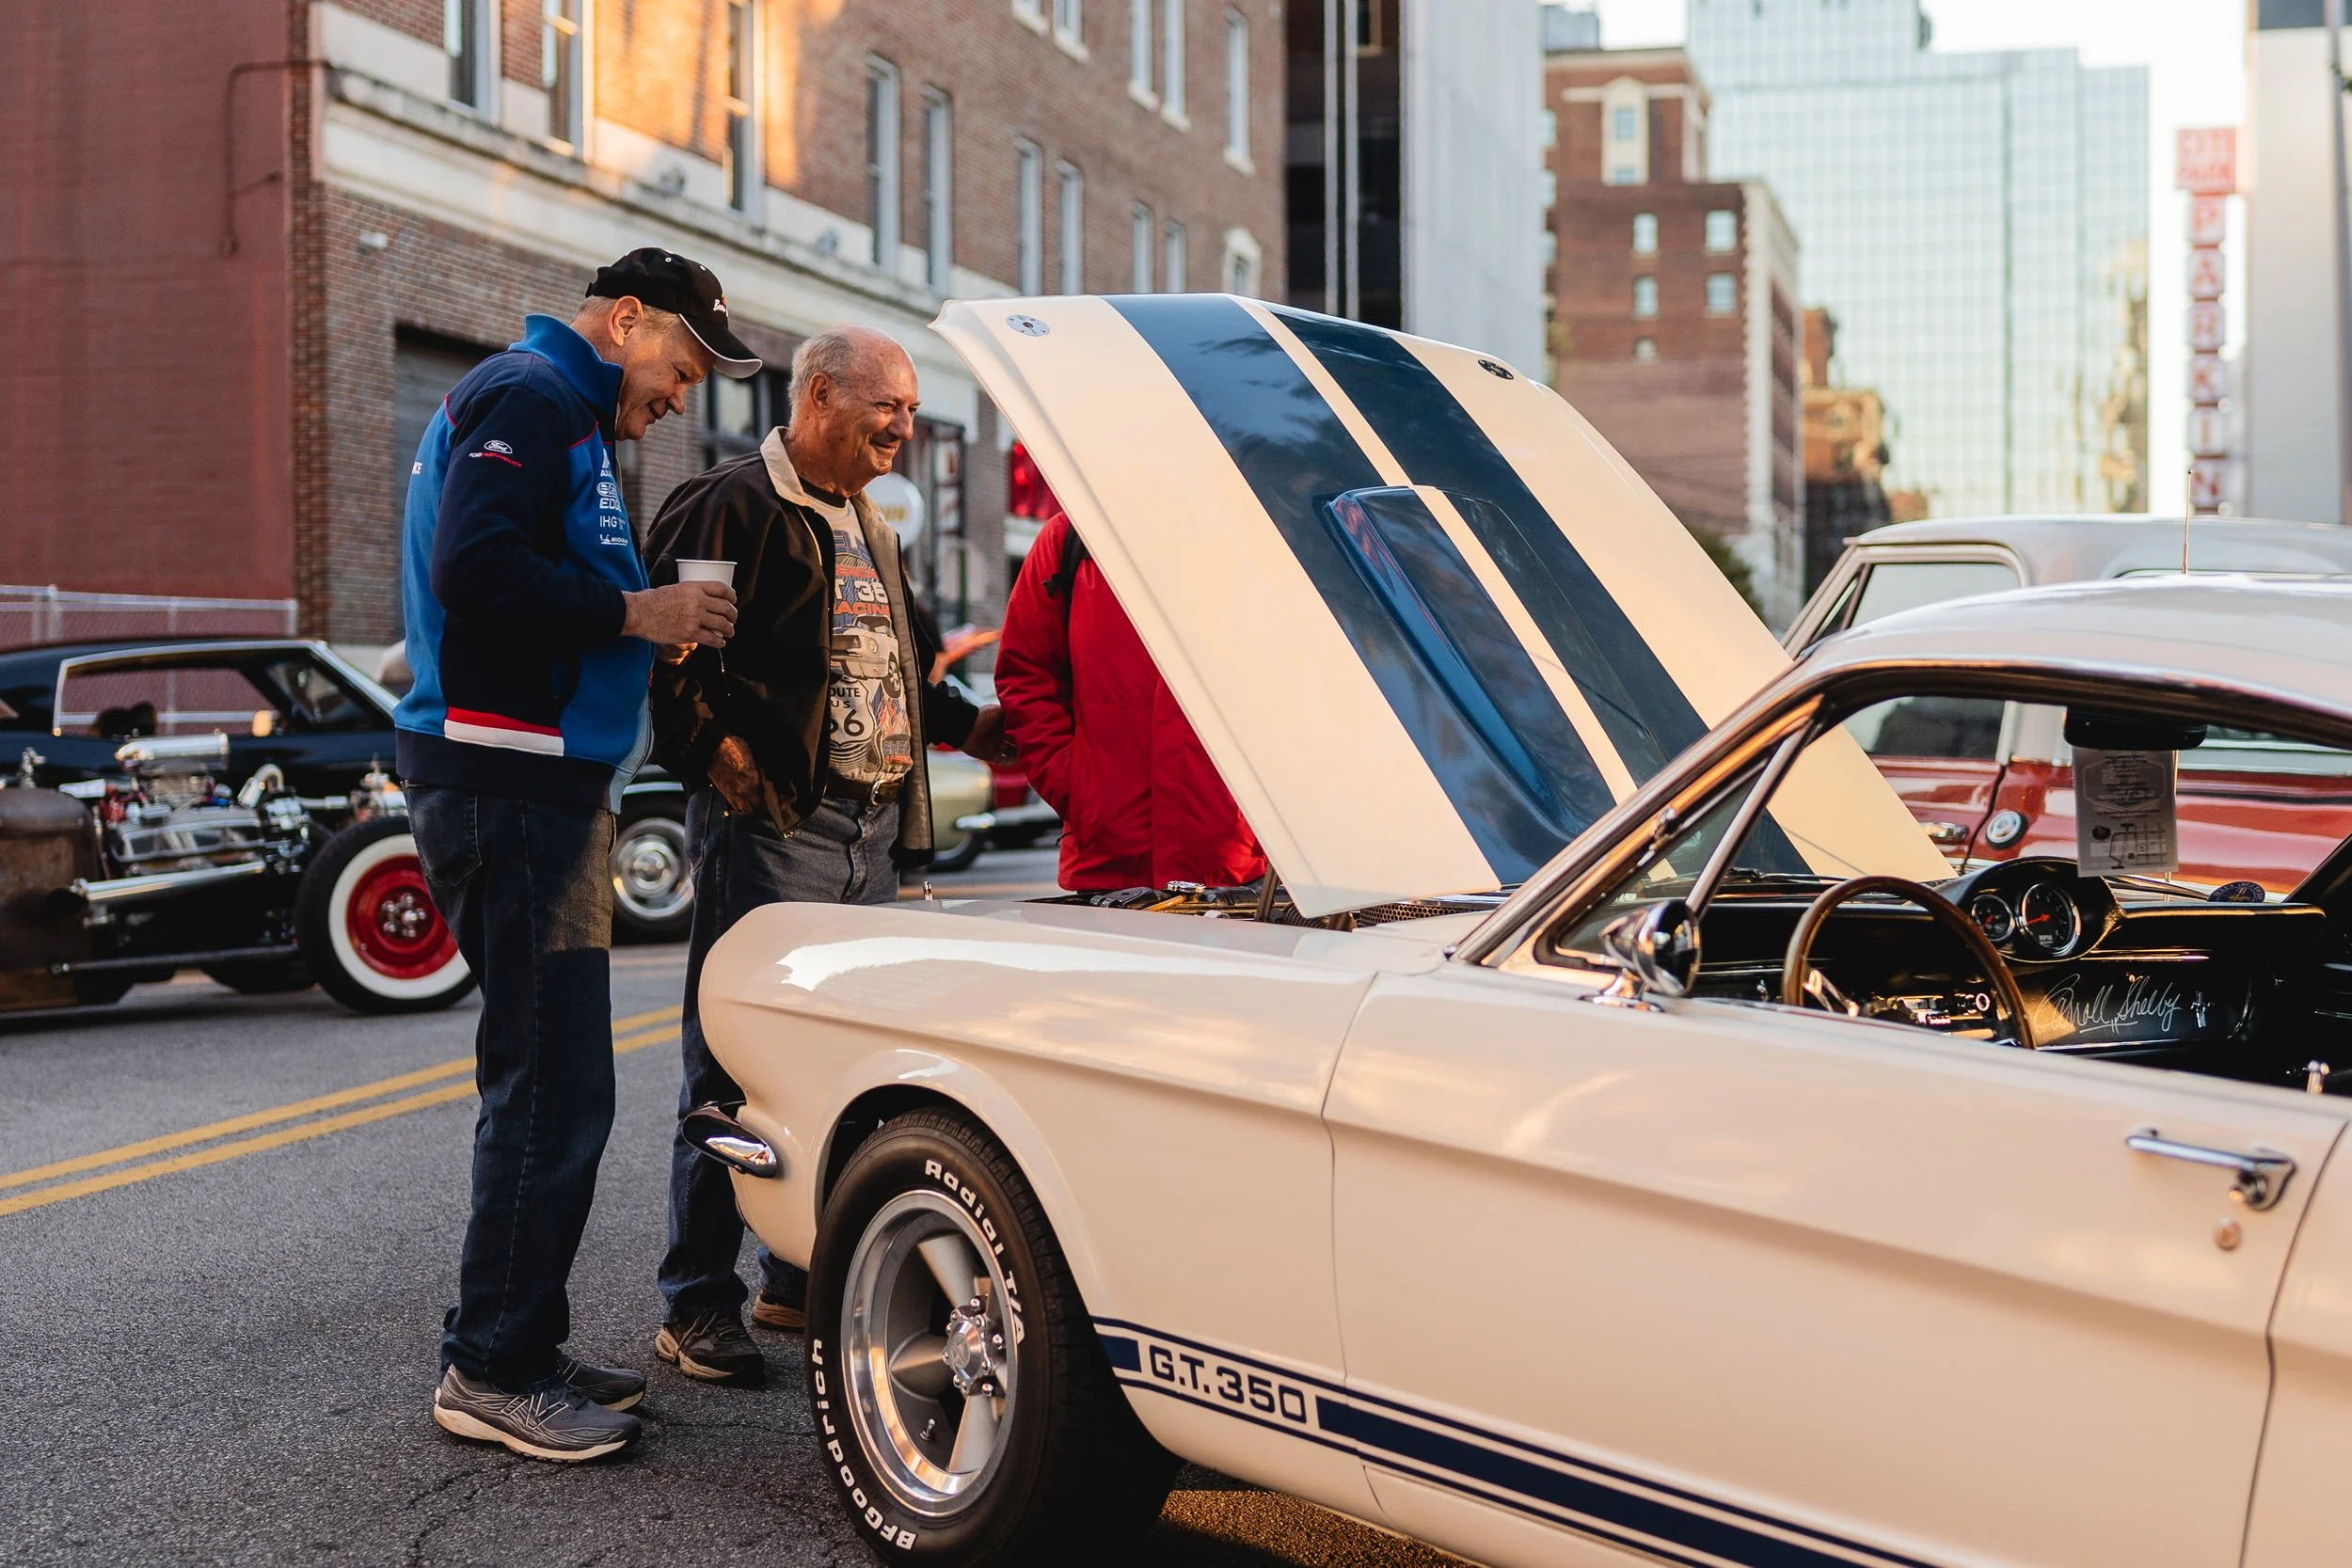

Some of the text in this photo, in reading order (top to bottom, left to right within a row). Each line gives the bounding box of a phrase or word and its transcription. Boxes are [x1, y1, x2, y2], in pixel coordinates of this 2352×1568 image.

[599, 515, 618, 528] IHG
[853, 579, 889, 604] 35
[834, 600, 891, 617] ACIN
[830, 687, 861, 698] OUTE
[2115, 974, 2182, 1032] Shelby
[925, 1159, 1025, 1345] Radial T/A
[812, 1338, 917, 1550] BFGoodrich
